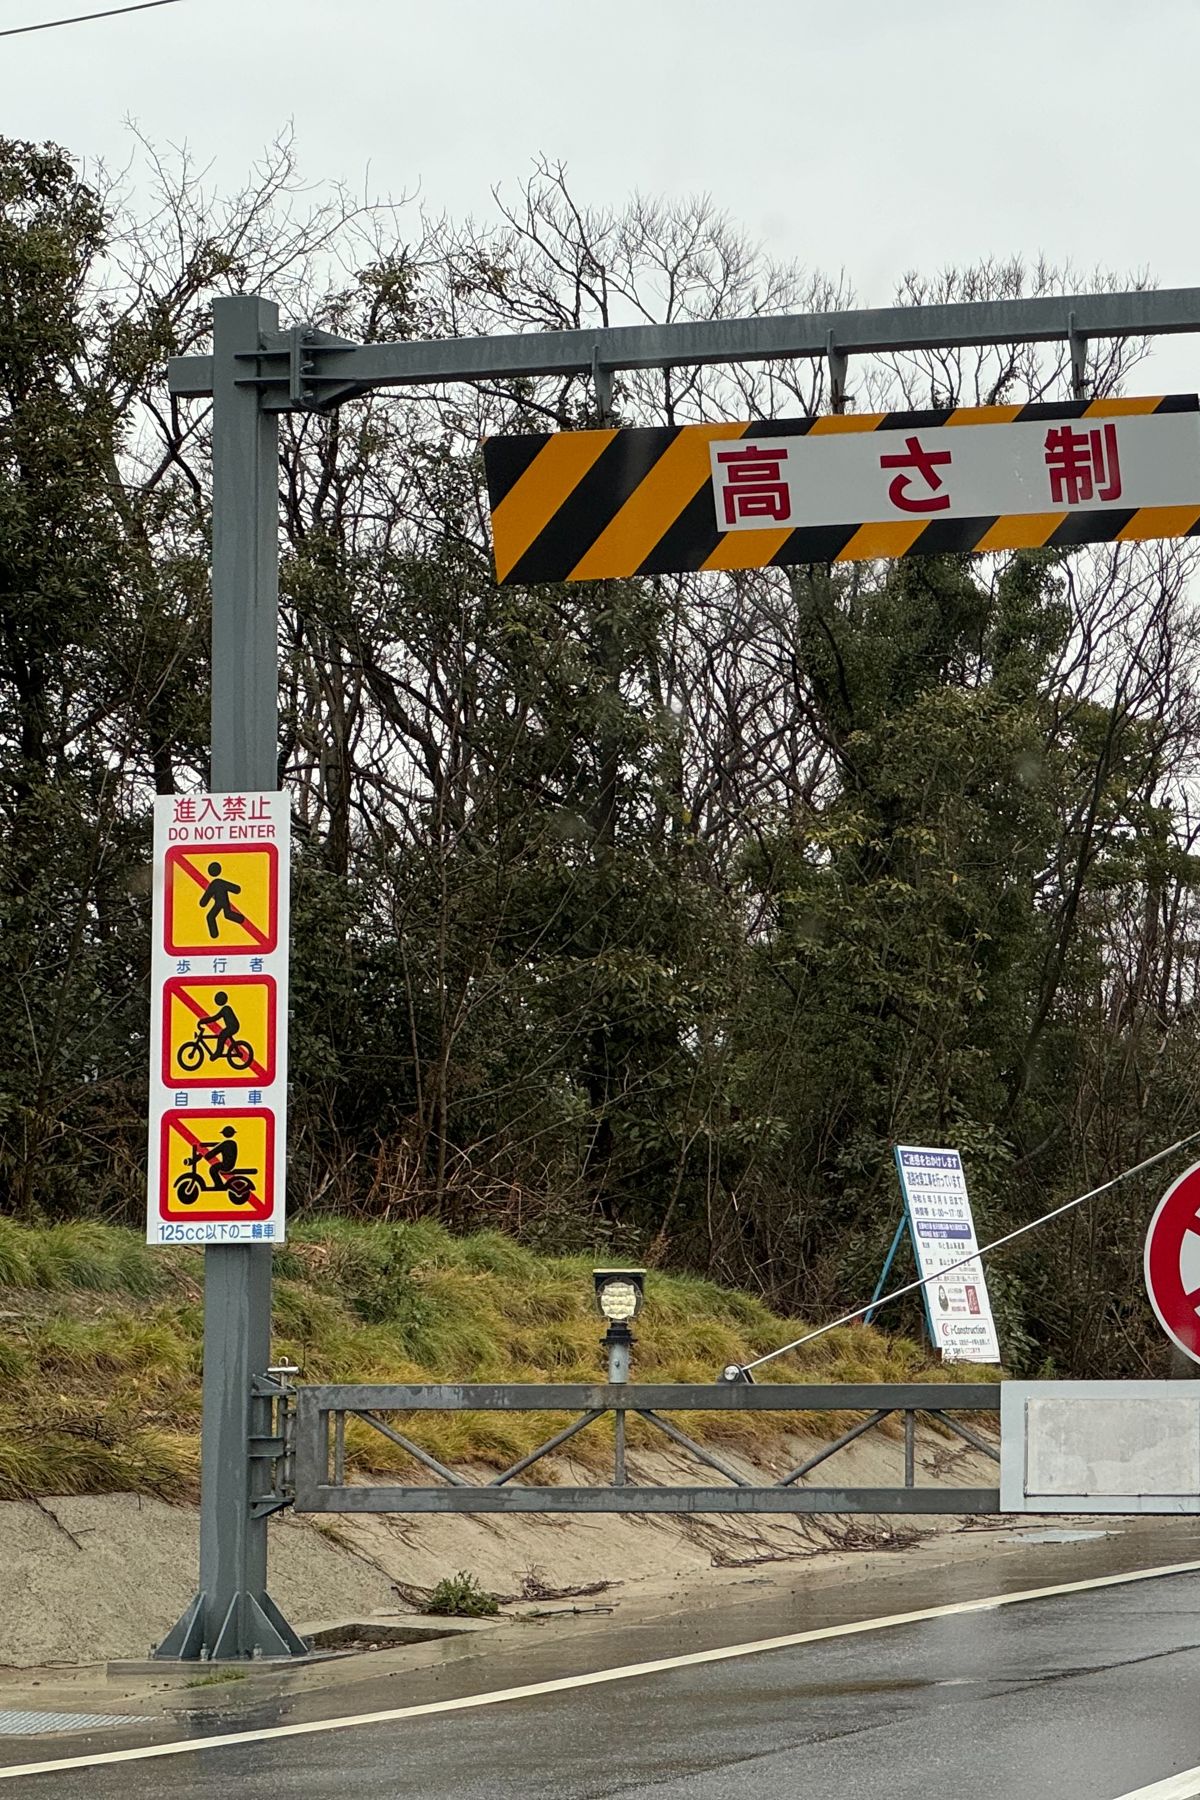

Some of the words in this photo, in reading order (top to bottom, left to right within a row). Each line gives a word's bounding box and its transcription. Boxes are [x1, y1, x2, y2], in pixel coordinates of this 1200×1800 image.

[173, 795, 272, 824] 進入禁止
[168, 827, 189, 840] DO
[194, 826, 224, 840] NOT
[229, 825, 276, 839] ENTER
[176, 958, 264, 974] 歩行者
[175, 1090, 262, 1107] 自転車
[159, 1223, 275, 1241] 125cc以下の二輪車
